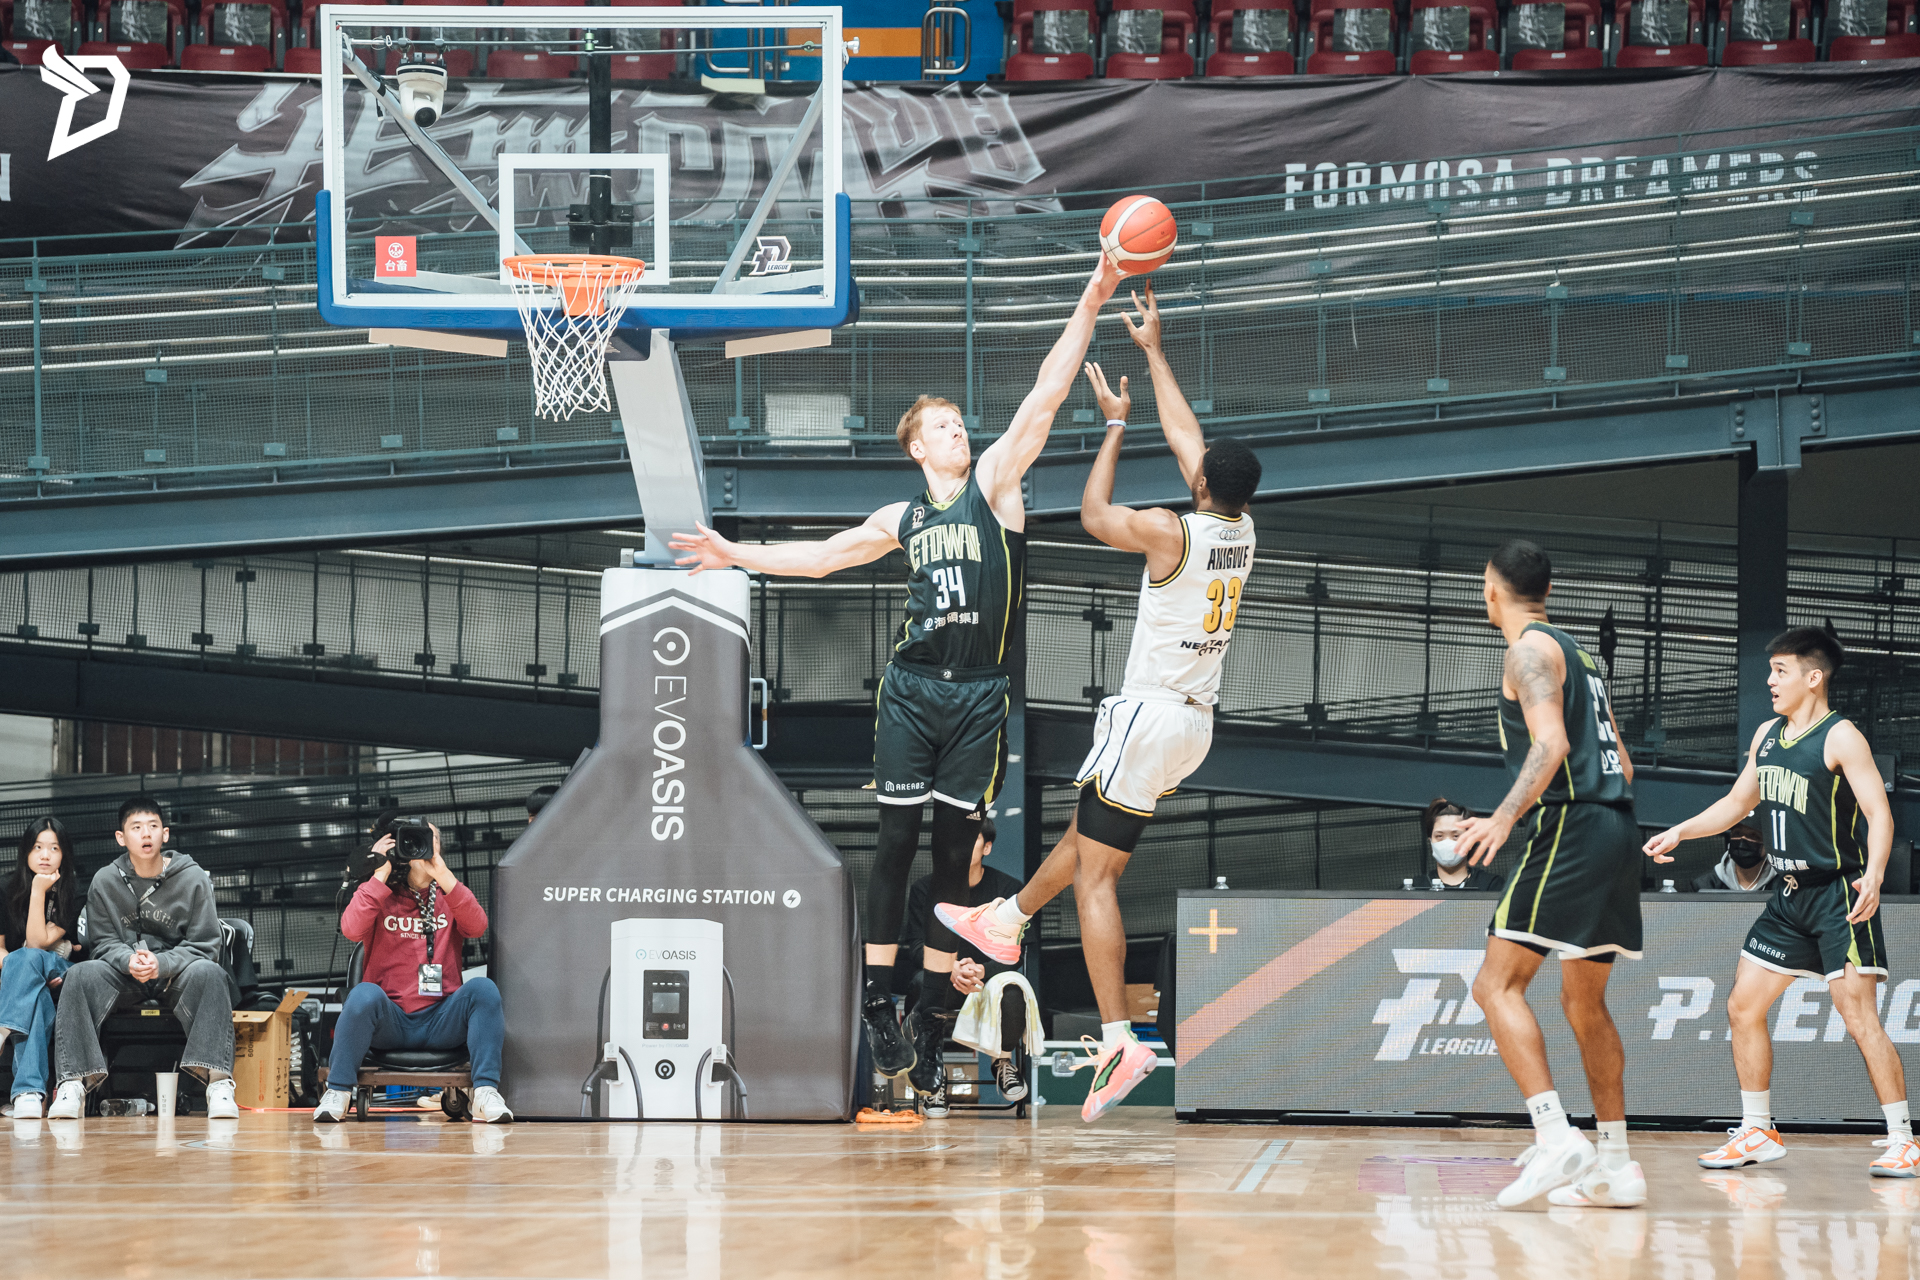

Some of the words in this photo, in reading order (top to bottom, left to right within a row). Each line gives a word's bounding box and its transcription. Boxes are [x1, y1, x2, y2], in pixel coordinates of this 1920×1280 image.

[1285, 158, 1518, 211] FORMOSA
[1546, 151, 1818, 204] DREAMERS
[385, 259, 407, 272] 台畜
[909, 523, 982, 573] CTOWN
[1206, 545, 1250, 571] ANIGWE
[932, 565, 967, 610] 34
[1202, 576, 1243, 634] 33
[651, 675, 687, 842] EVOASIS
[1756, 765, 1809, 815] TOWN
[1771, 808, 1787, 852] 11
[542, 886, 601, 902] SUPER
[605, 887, 697, 904] CHARGING
[702, 889, 776, 905] STATION
[400, 932, 420, 940] SINCE
[649, 949, 697, 961] EVOASIS
[1418, 1037, 1499, 1056] LEAGUE
